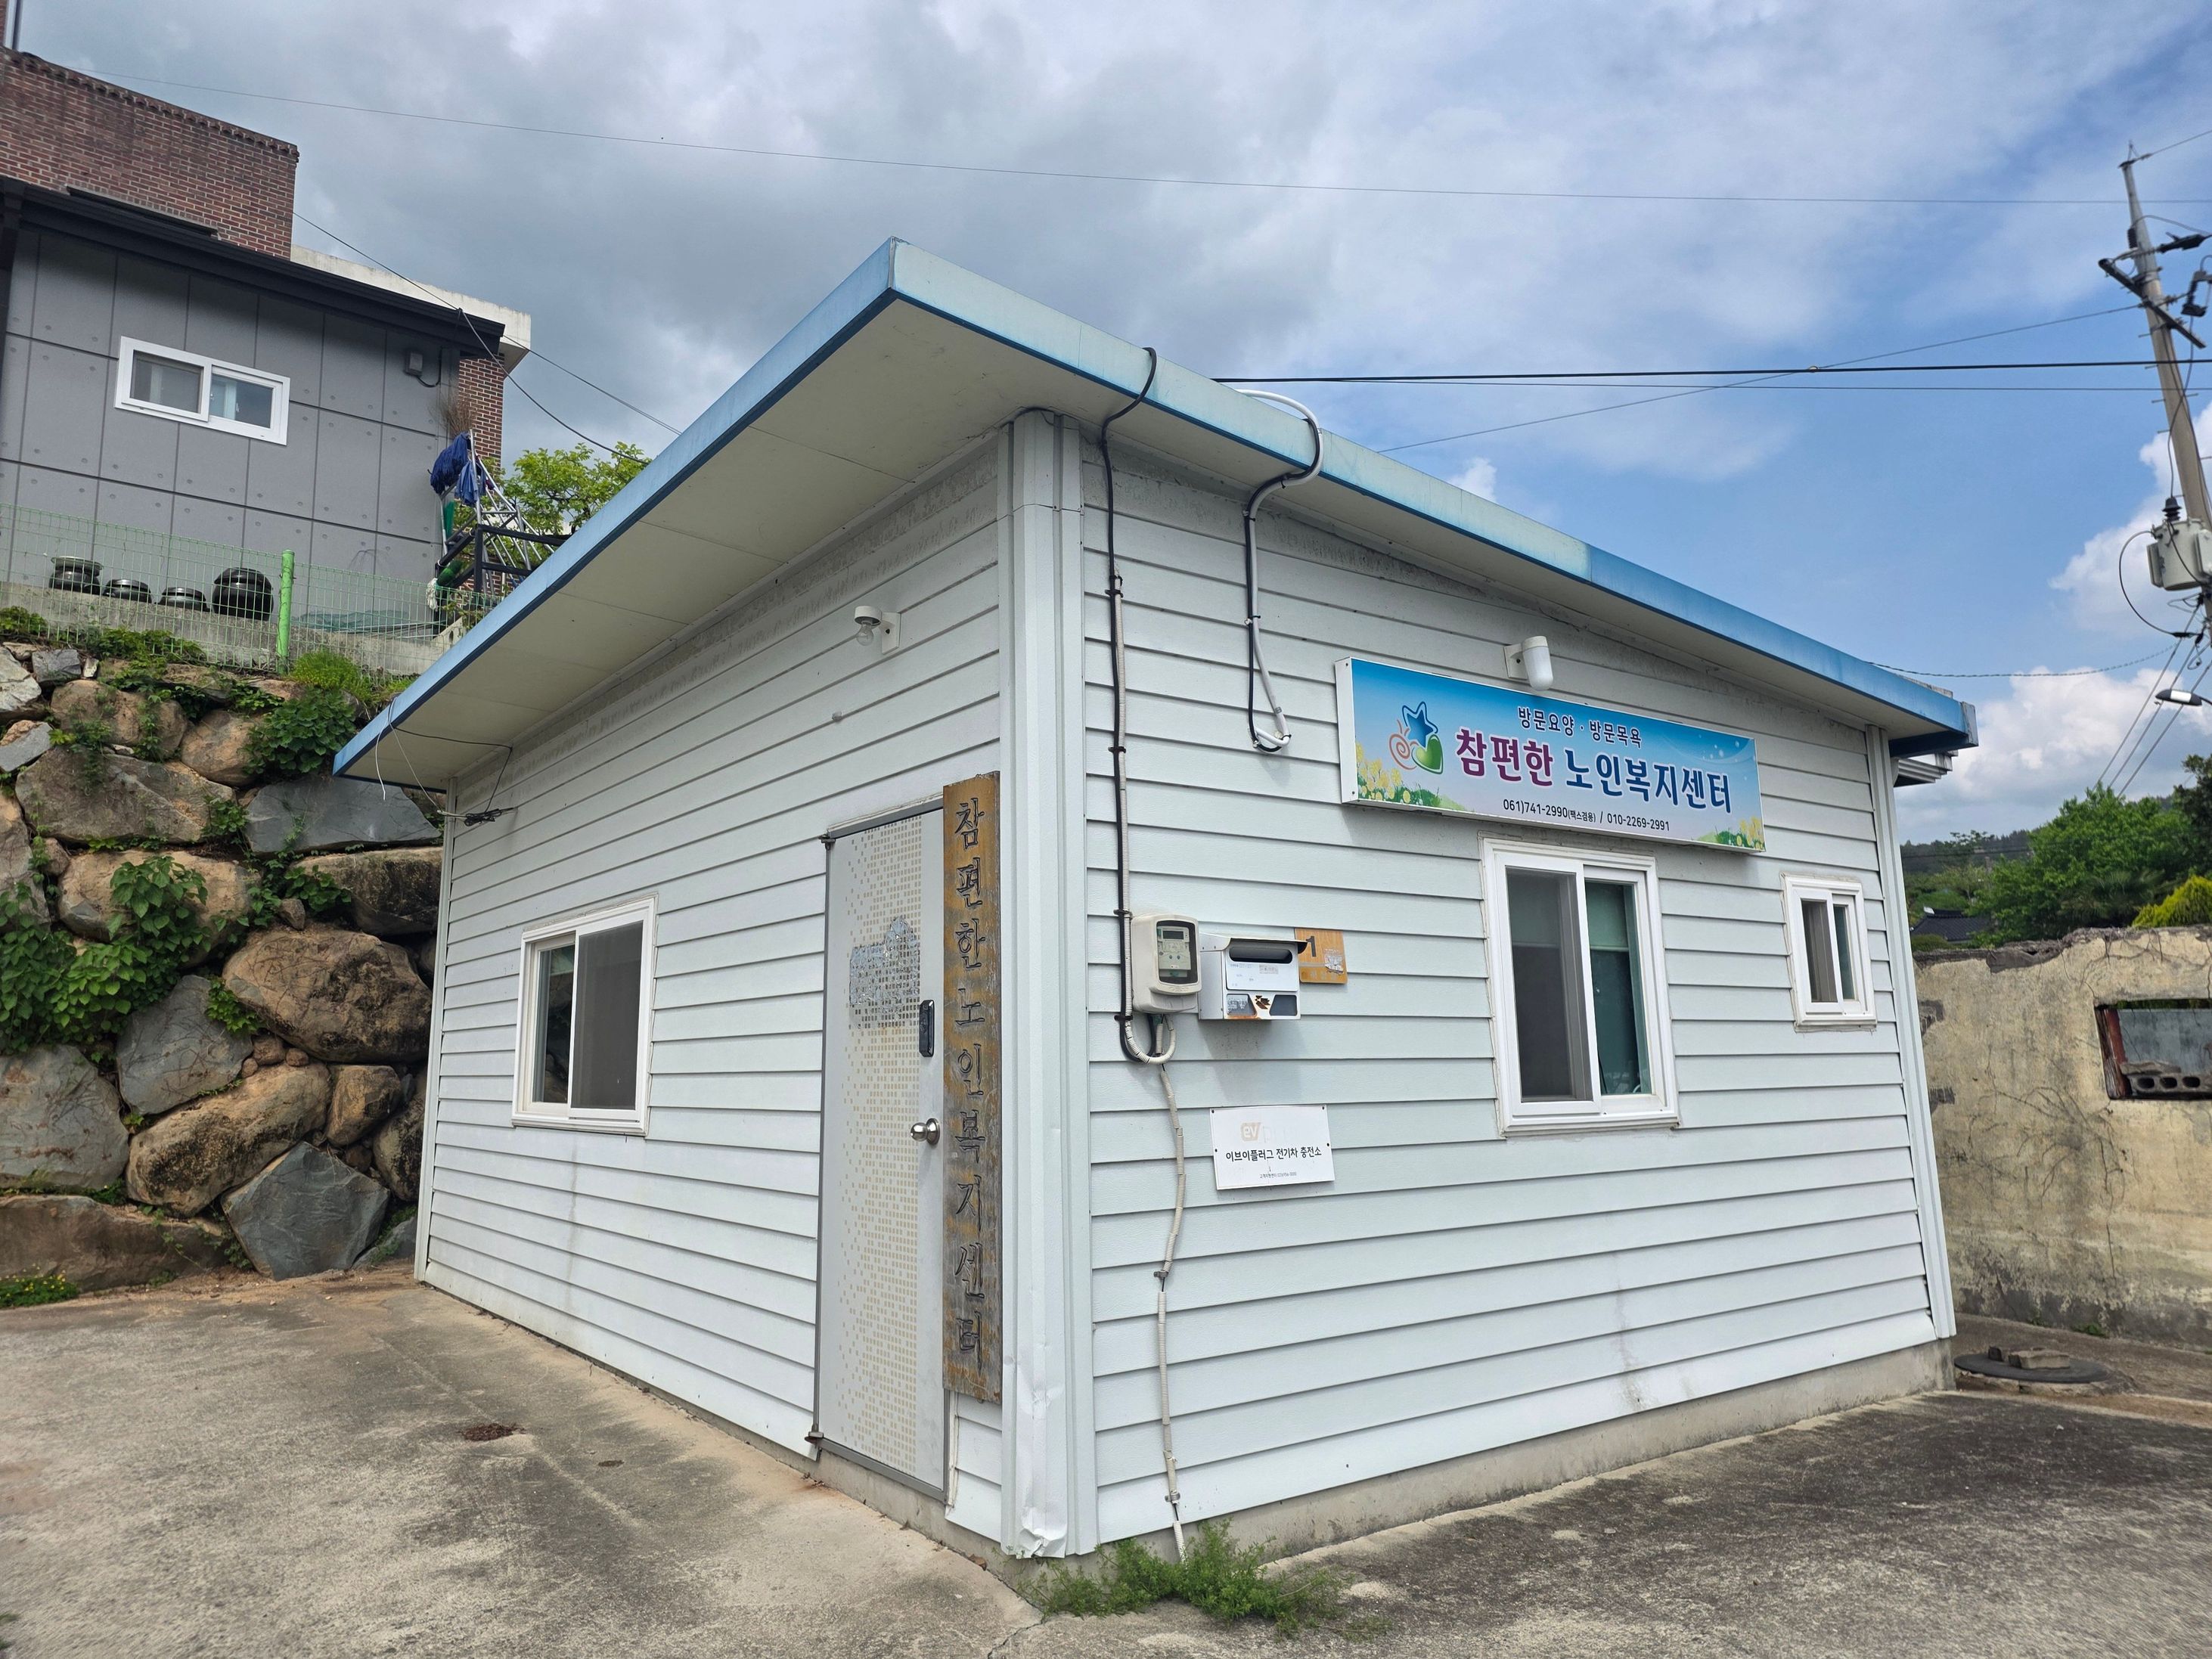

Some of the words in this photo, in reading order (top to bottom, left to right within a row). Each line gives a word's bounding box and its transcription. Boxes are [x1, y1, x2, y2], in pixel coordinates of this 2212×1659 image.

[1518, 707, 1574, 736] 방문요양
[1590, 721, 1642, 749] 방문목욕
[1456, 728, 1553, 787] 참편한
[1565, 749, 1732, 814] 노인복지센터
[1607, 813, 1670, 831] 010-2269-2991
[1225, 1149, 1274, 1161] 이브이플러그
[1276, 1147, 1298, 1159] 전기차
[1300, 1146, 1322, 1158] 충전소
